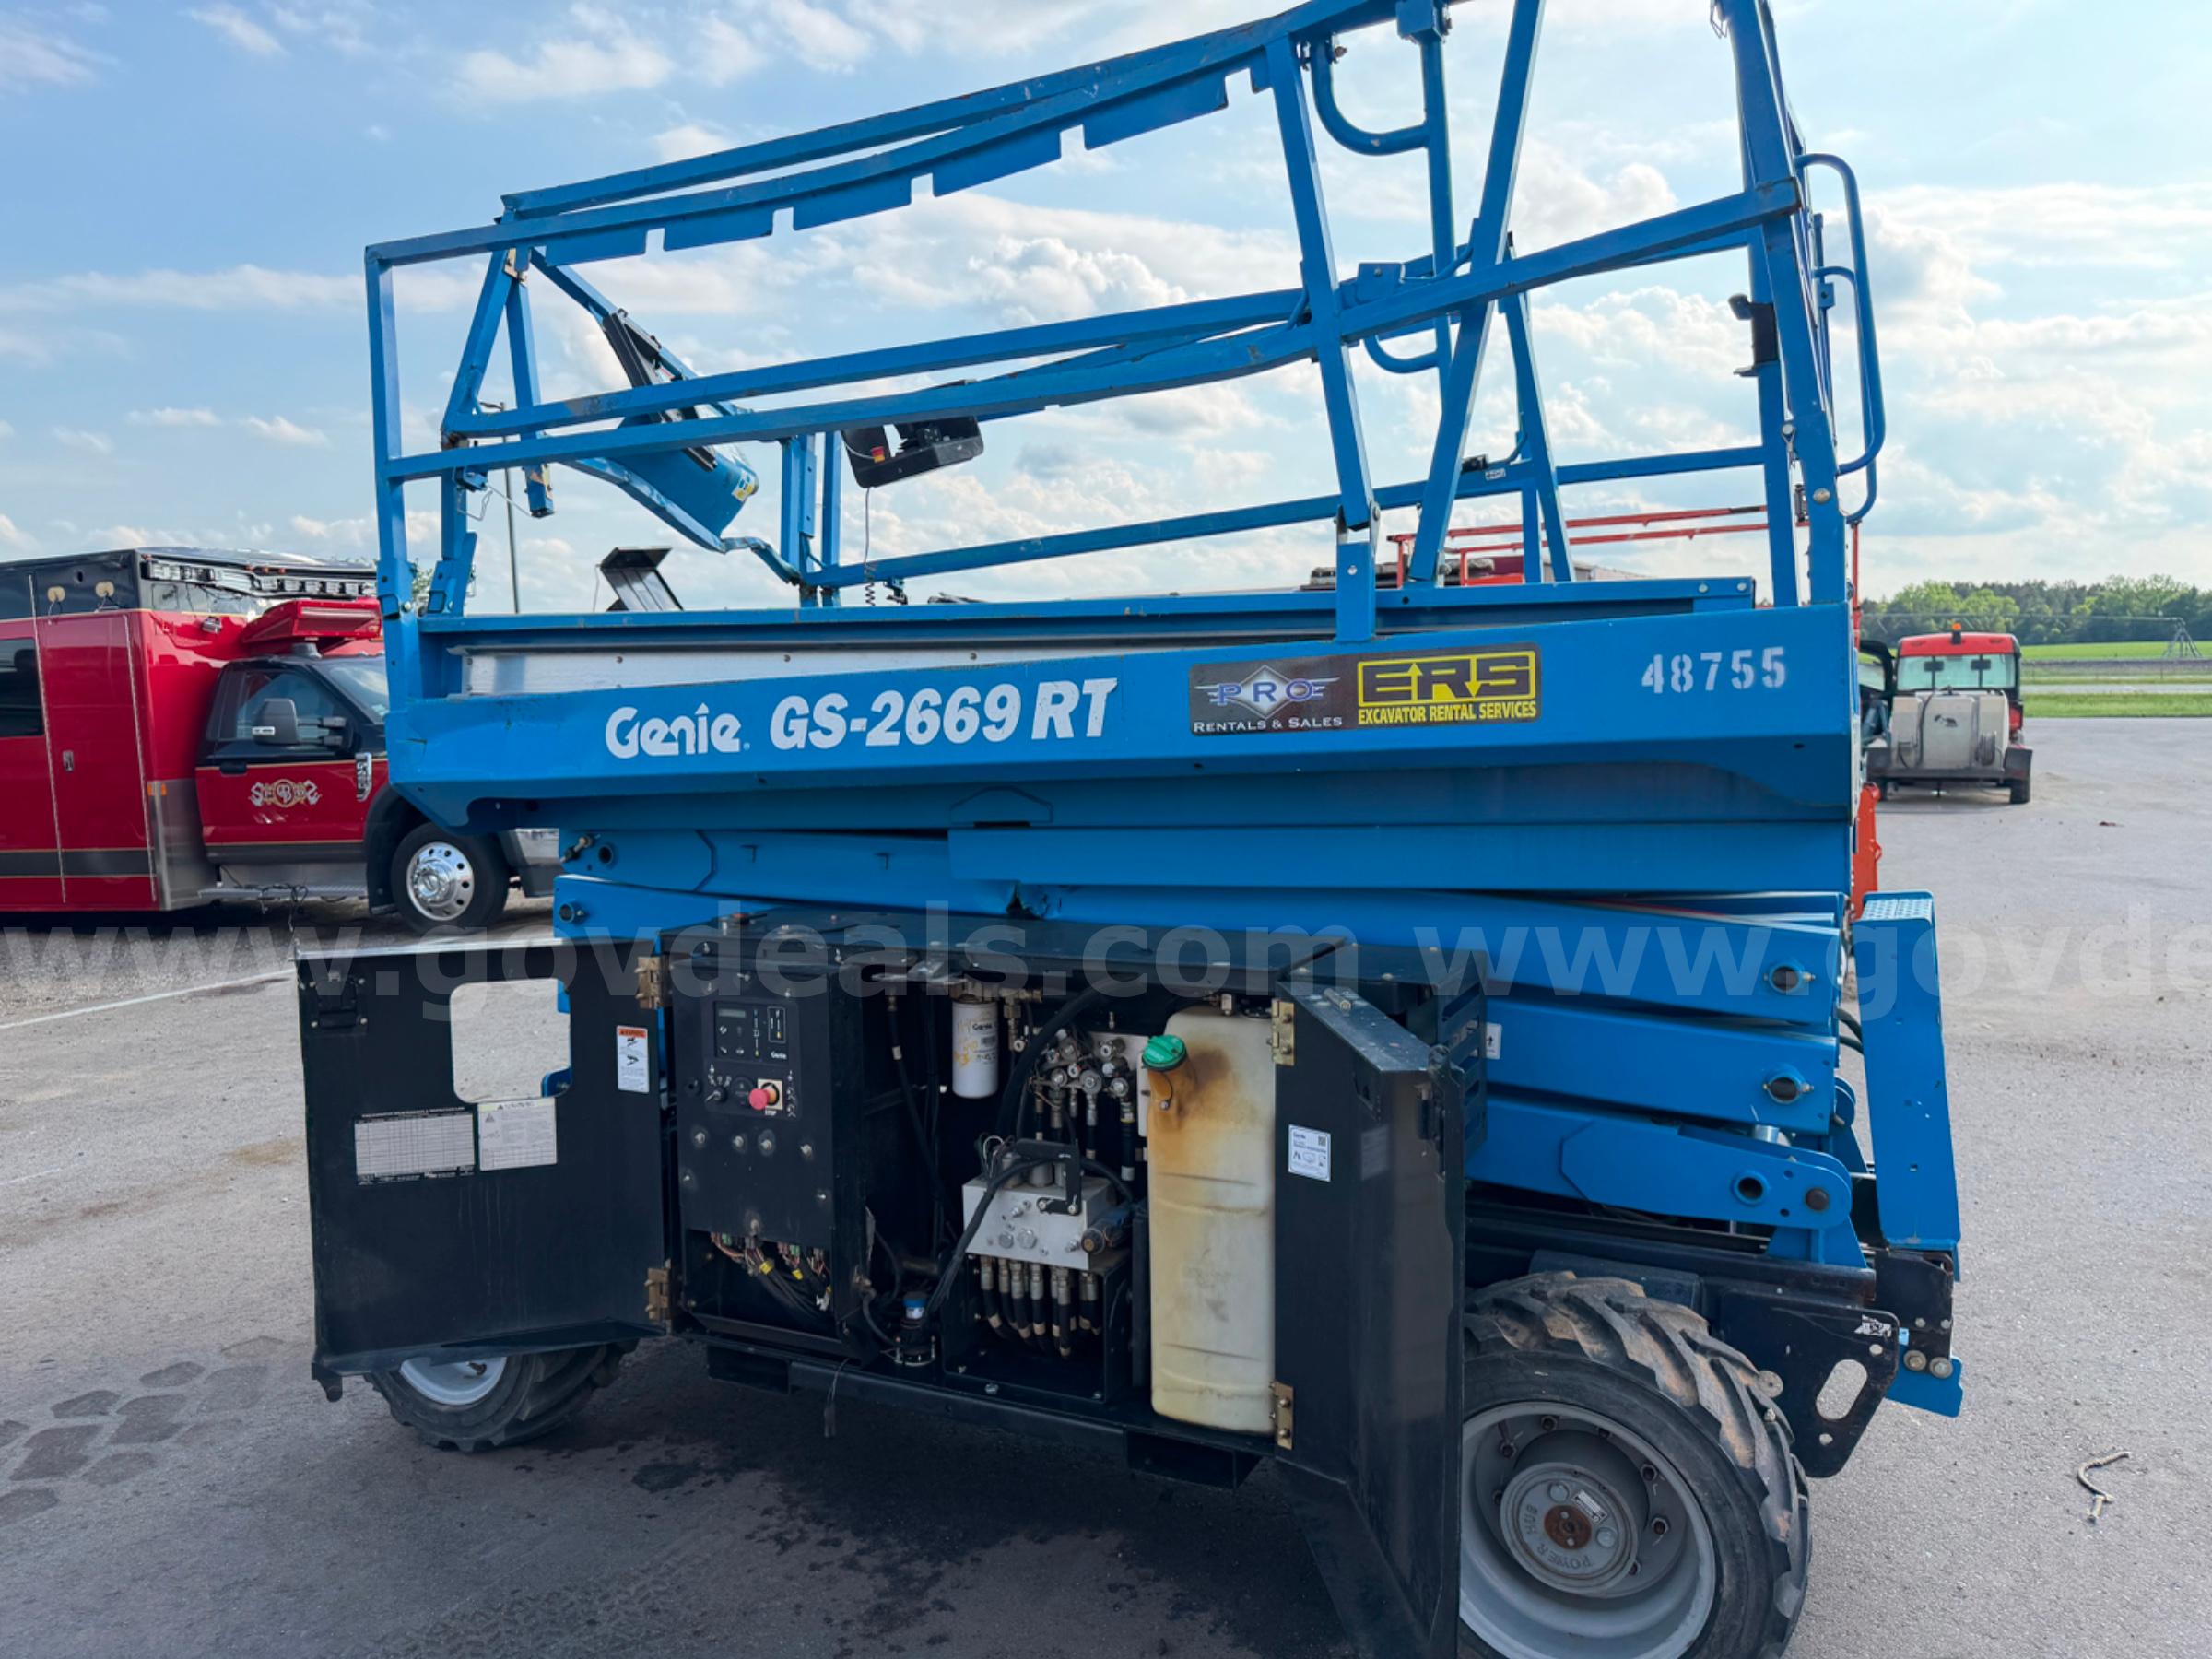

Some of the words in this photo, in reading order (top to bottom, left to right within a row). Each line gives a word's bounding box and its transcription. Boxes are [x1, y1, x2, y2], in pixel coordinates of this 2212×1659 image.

[1361, 653, 1532, 703] ERS
[1641, 646, 1787, 694] 48755
[1217, 677, 1313, 707] PRO
[605, 702, 742, 759] Genie
[770, 683, 1021, 751] GS-2669
[1031, 677, 1118, 741] RT
[1194, 718, 1266, 734] RENTALS
[1272, 718, 1283, 730] &
[1288, 716, 1343, 729] SALES
[1358, 705, 1427, 725] EXCAVATOR
[1429, 703, 1477, 722] RENTAL
[1478, 700, 1537, 720] SERVICES
